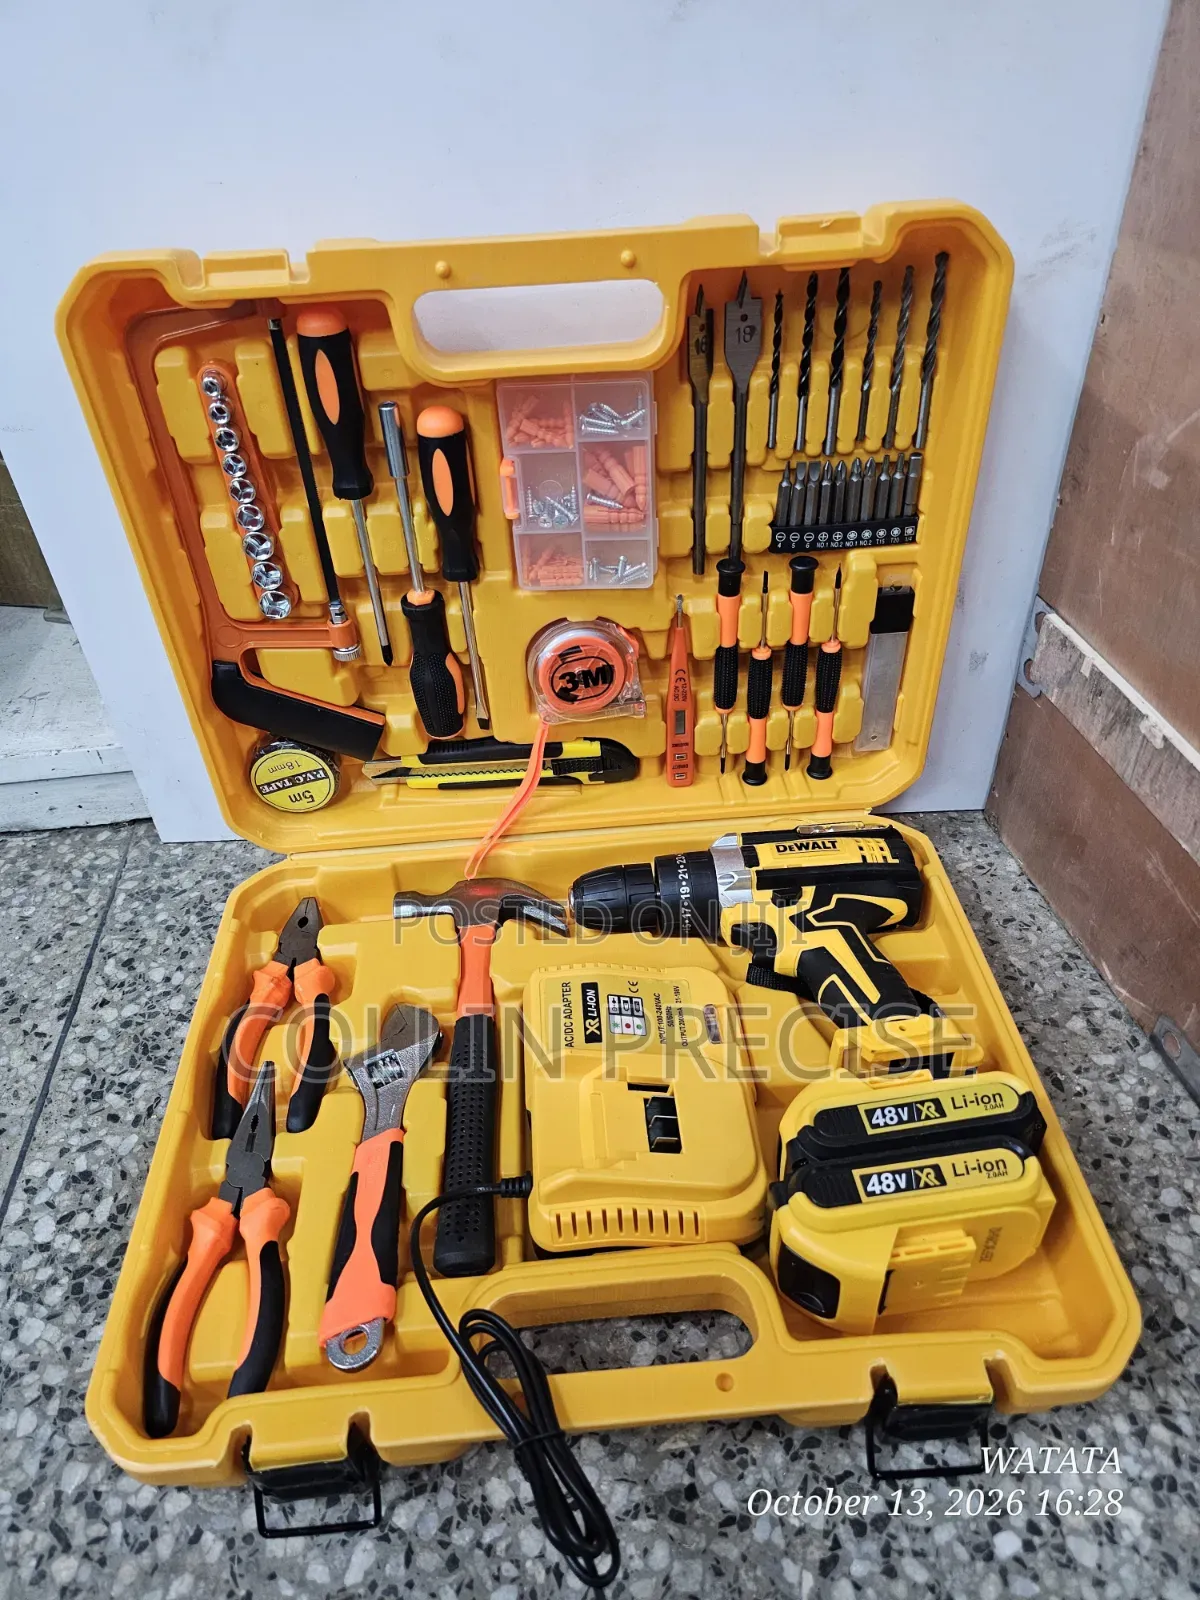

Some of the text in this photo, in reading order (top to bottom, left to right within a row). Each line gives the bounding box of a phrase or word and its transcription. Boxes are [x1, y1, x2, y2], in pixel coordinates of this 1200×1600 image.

[558, 664, 615, 693] 3M
[260, 778, 293, 794] TAPE
[288, 790, 315, 804] 5m
[775, 839, 838, 854] DEWALT
[586, 989, 597, 1017] LI-ION
[561, 981, 575, 1048] AC/DC ADAPTER
[951, 1091, 1004, 1110] Li-ion
[951, 1158, 1008, 1177] Li-ion
